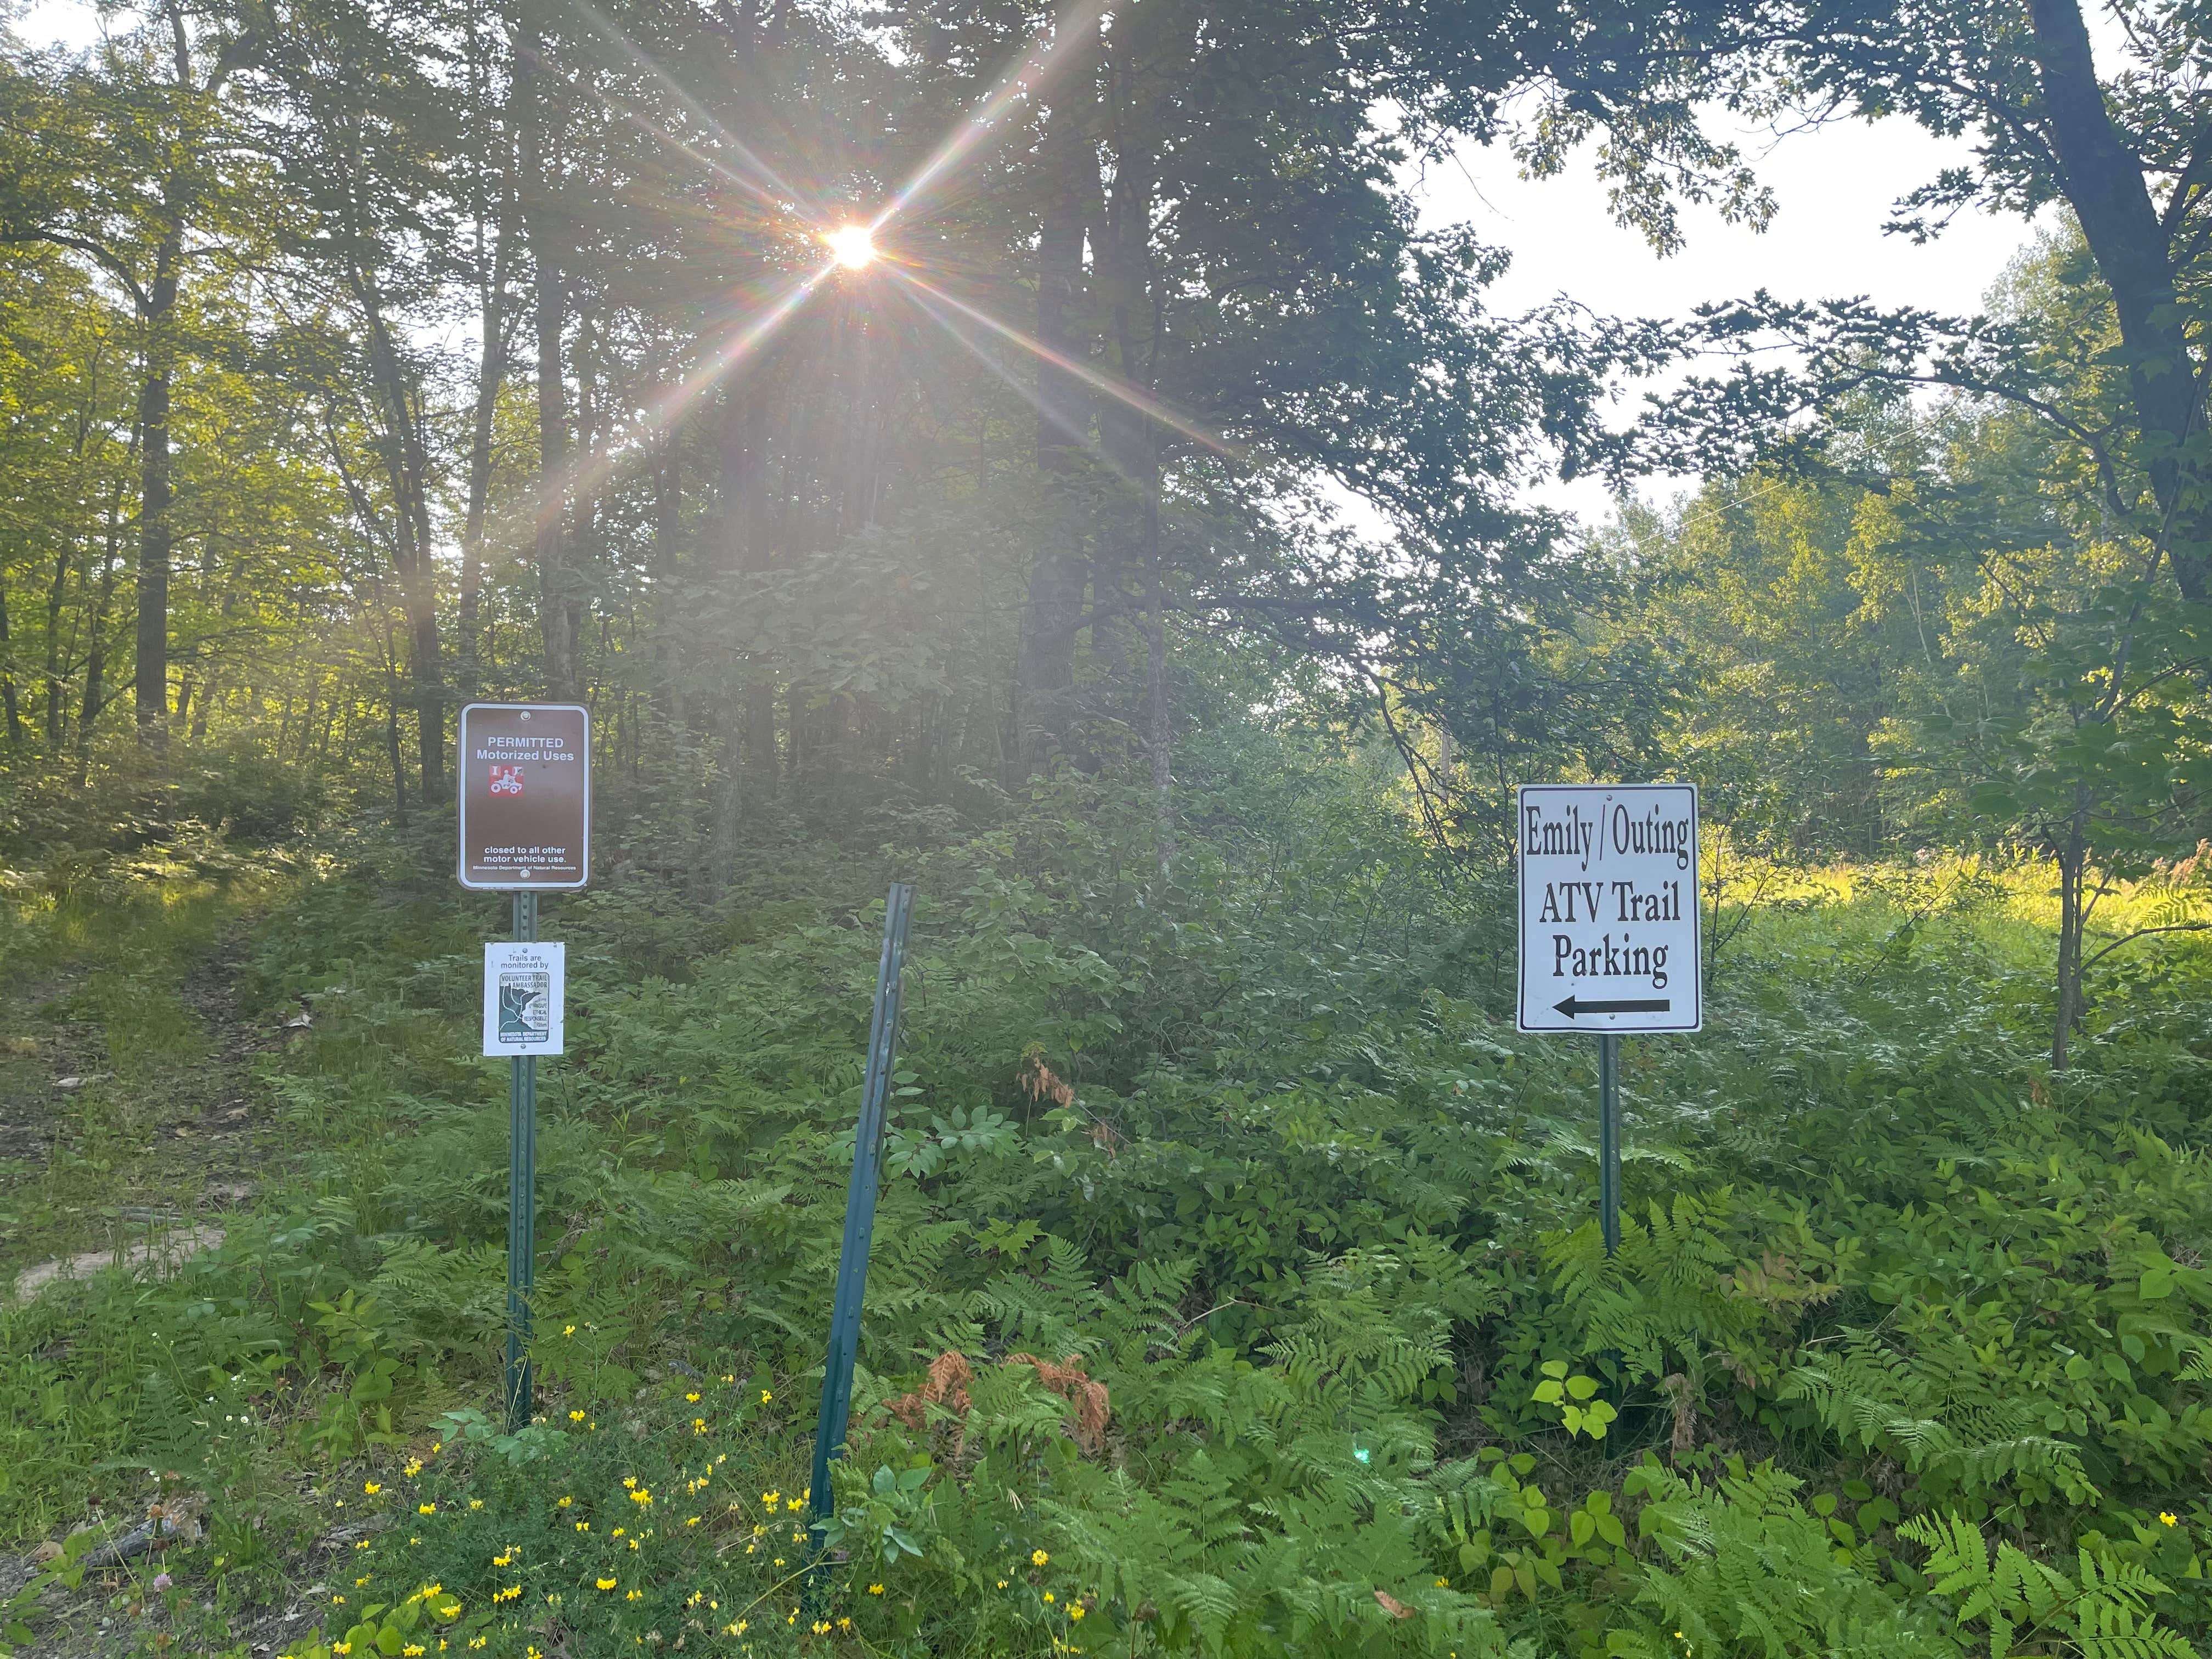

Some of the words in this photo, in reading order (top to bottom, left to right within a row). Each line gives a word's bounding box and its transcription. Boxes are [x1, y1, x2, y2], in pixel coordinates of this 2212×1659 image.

[477, 749, 539, 760] Motorized
[543, 751, 574, 761] Uses
[488, 737, 564, 748] PERMITTED
[1526, 805, 1593, 871] Emily
[1613, 804, 1689, 870] Outing
[1539, 882, 1604, 923] ATV
[1612, 880, 1680, 922] Trail
[1553, 933, 1669, 989] Parking
